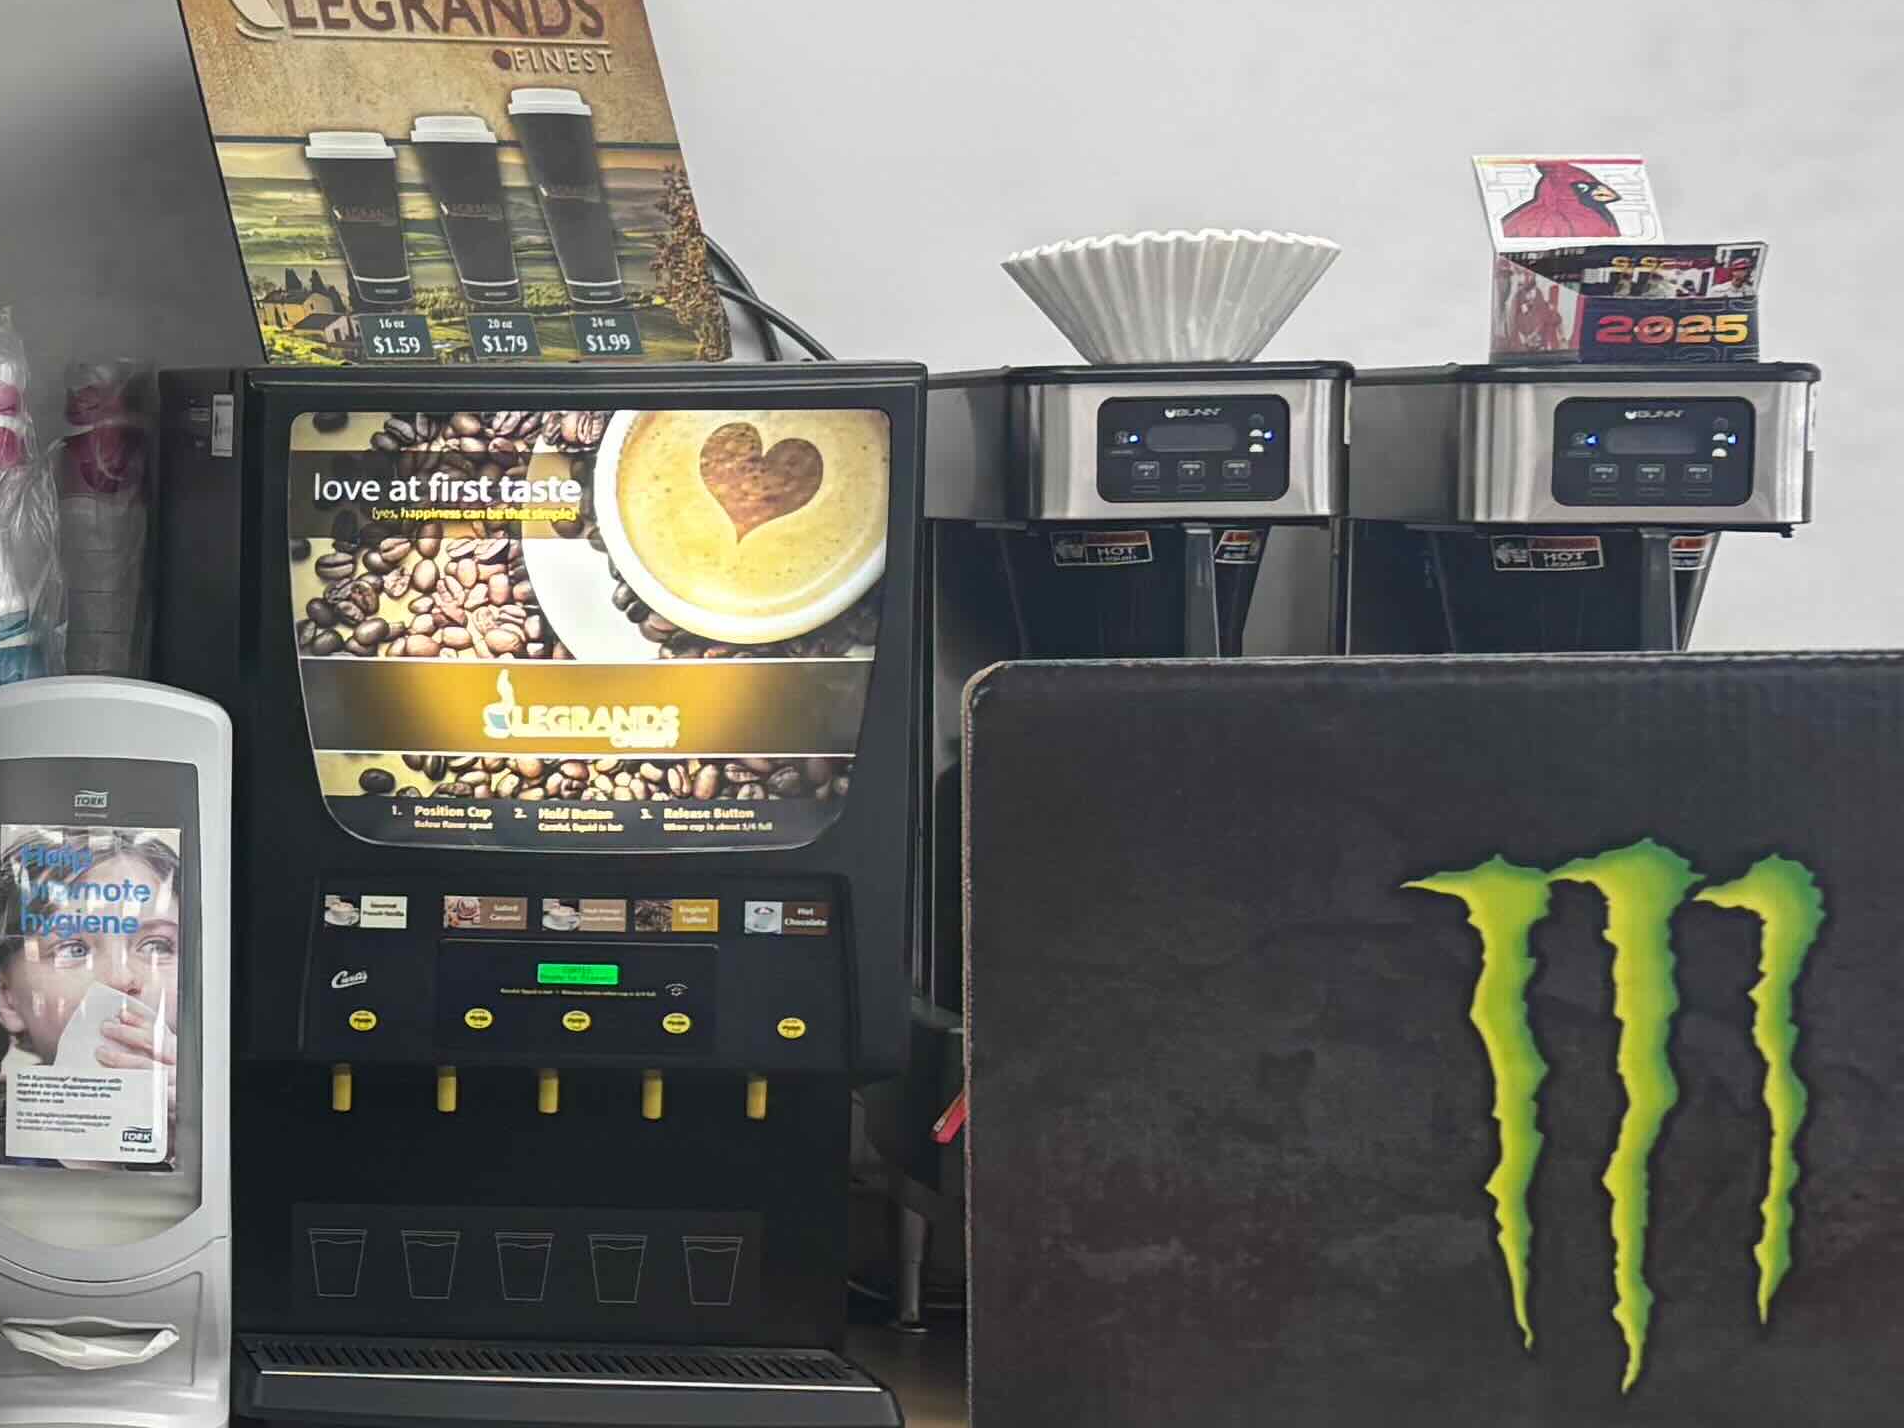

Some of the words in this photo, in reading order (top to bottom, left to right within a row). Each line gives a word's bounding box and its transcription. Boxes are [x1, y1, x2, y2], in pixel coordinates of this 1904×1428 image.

[510, 48, 614, 73] FINEST
[1596, 315, 1749, 344] 2025
[372, 334, 421, 356] $1.59
[482, 333, 528, 355] $1.79
[586, 332, 631, 354] $1.99
[314, 472, 381, 502] love
[389, 475, 421, 502] at
[428, 471, 492, 502] first
[499, 475, 582, 503] taste
[400, 507, 462, 522] happiness
[414, 805, 465, 818] Position
[467, 807, 492, 820] Cup
[713, 808, 755, 819] Button
[20, 908, 140, 938] hygiene
